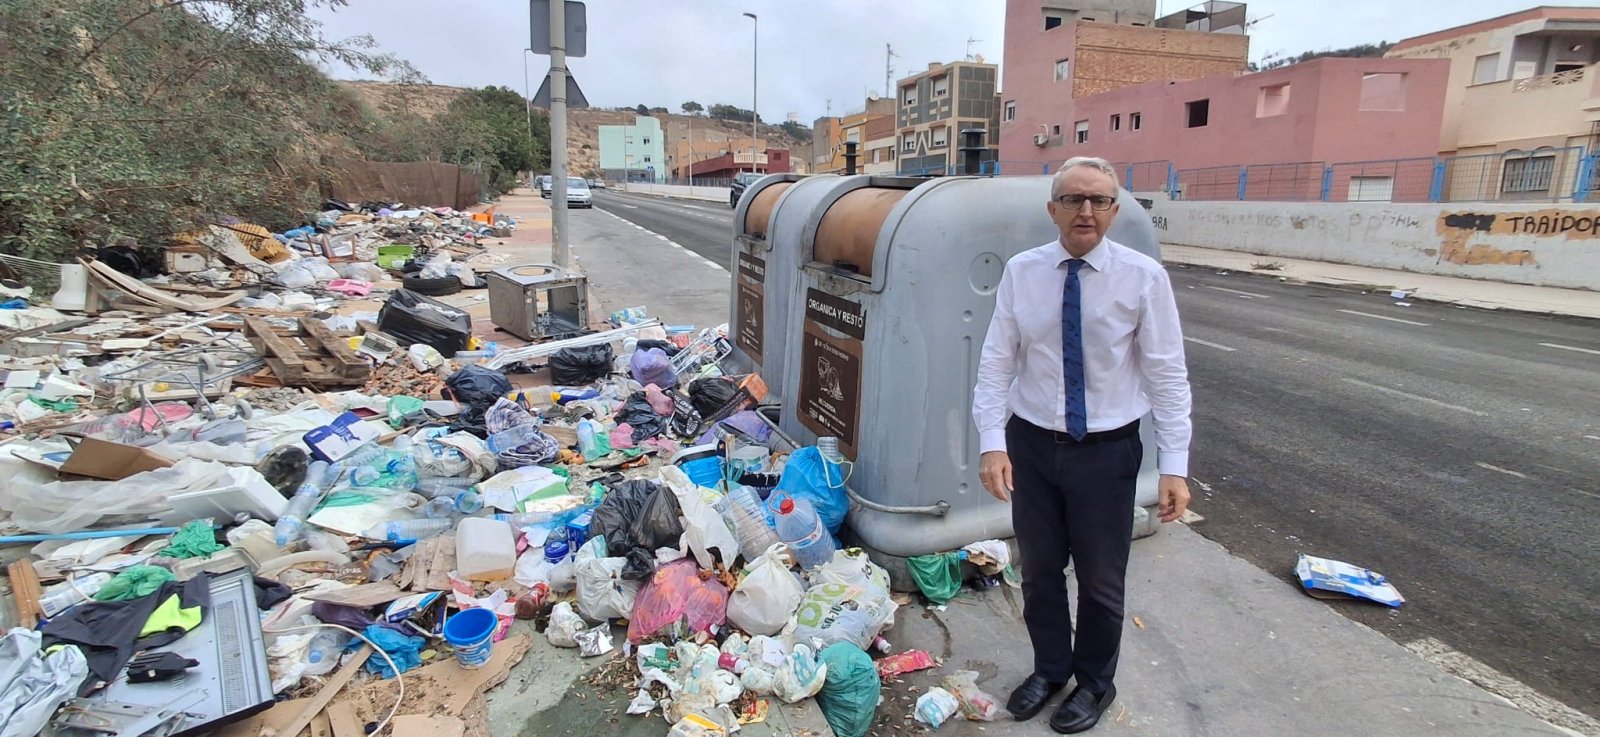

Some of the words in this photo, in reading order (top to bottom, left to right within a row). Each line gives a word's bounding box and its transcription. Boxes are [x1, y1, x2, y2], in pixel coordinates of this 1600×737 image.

[808, 298, 837, 319] ORGANICA
[837, 309, 842, 320] Y
[842, 311, 864, 328] RESTO
